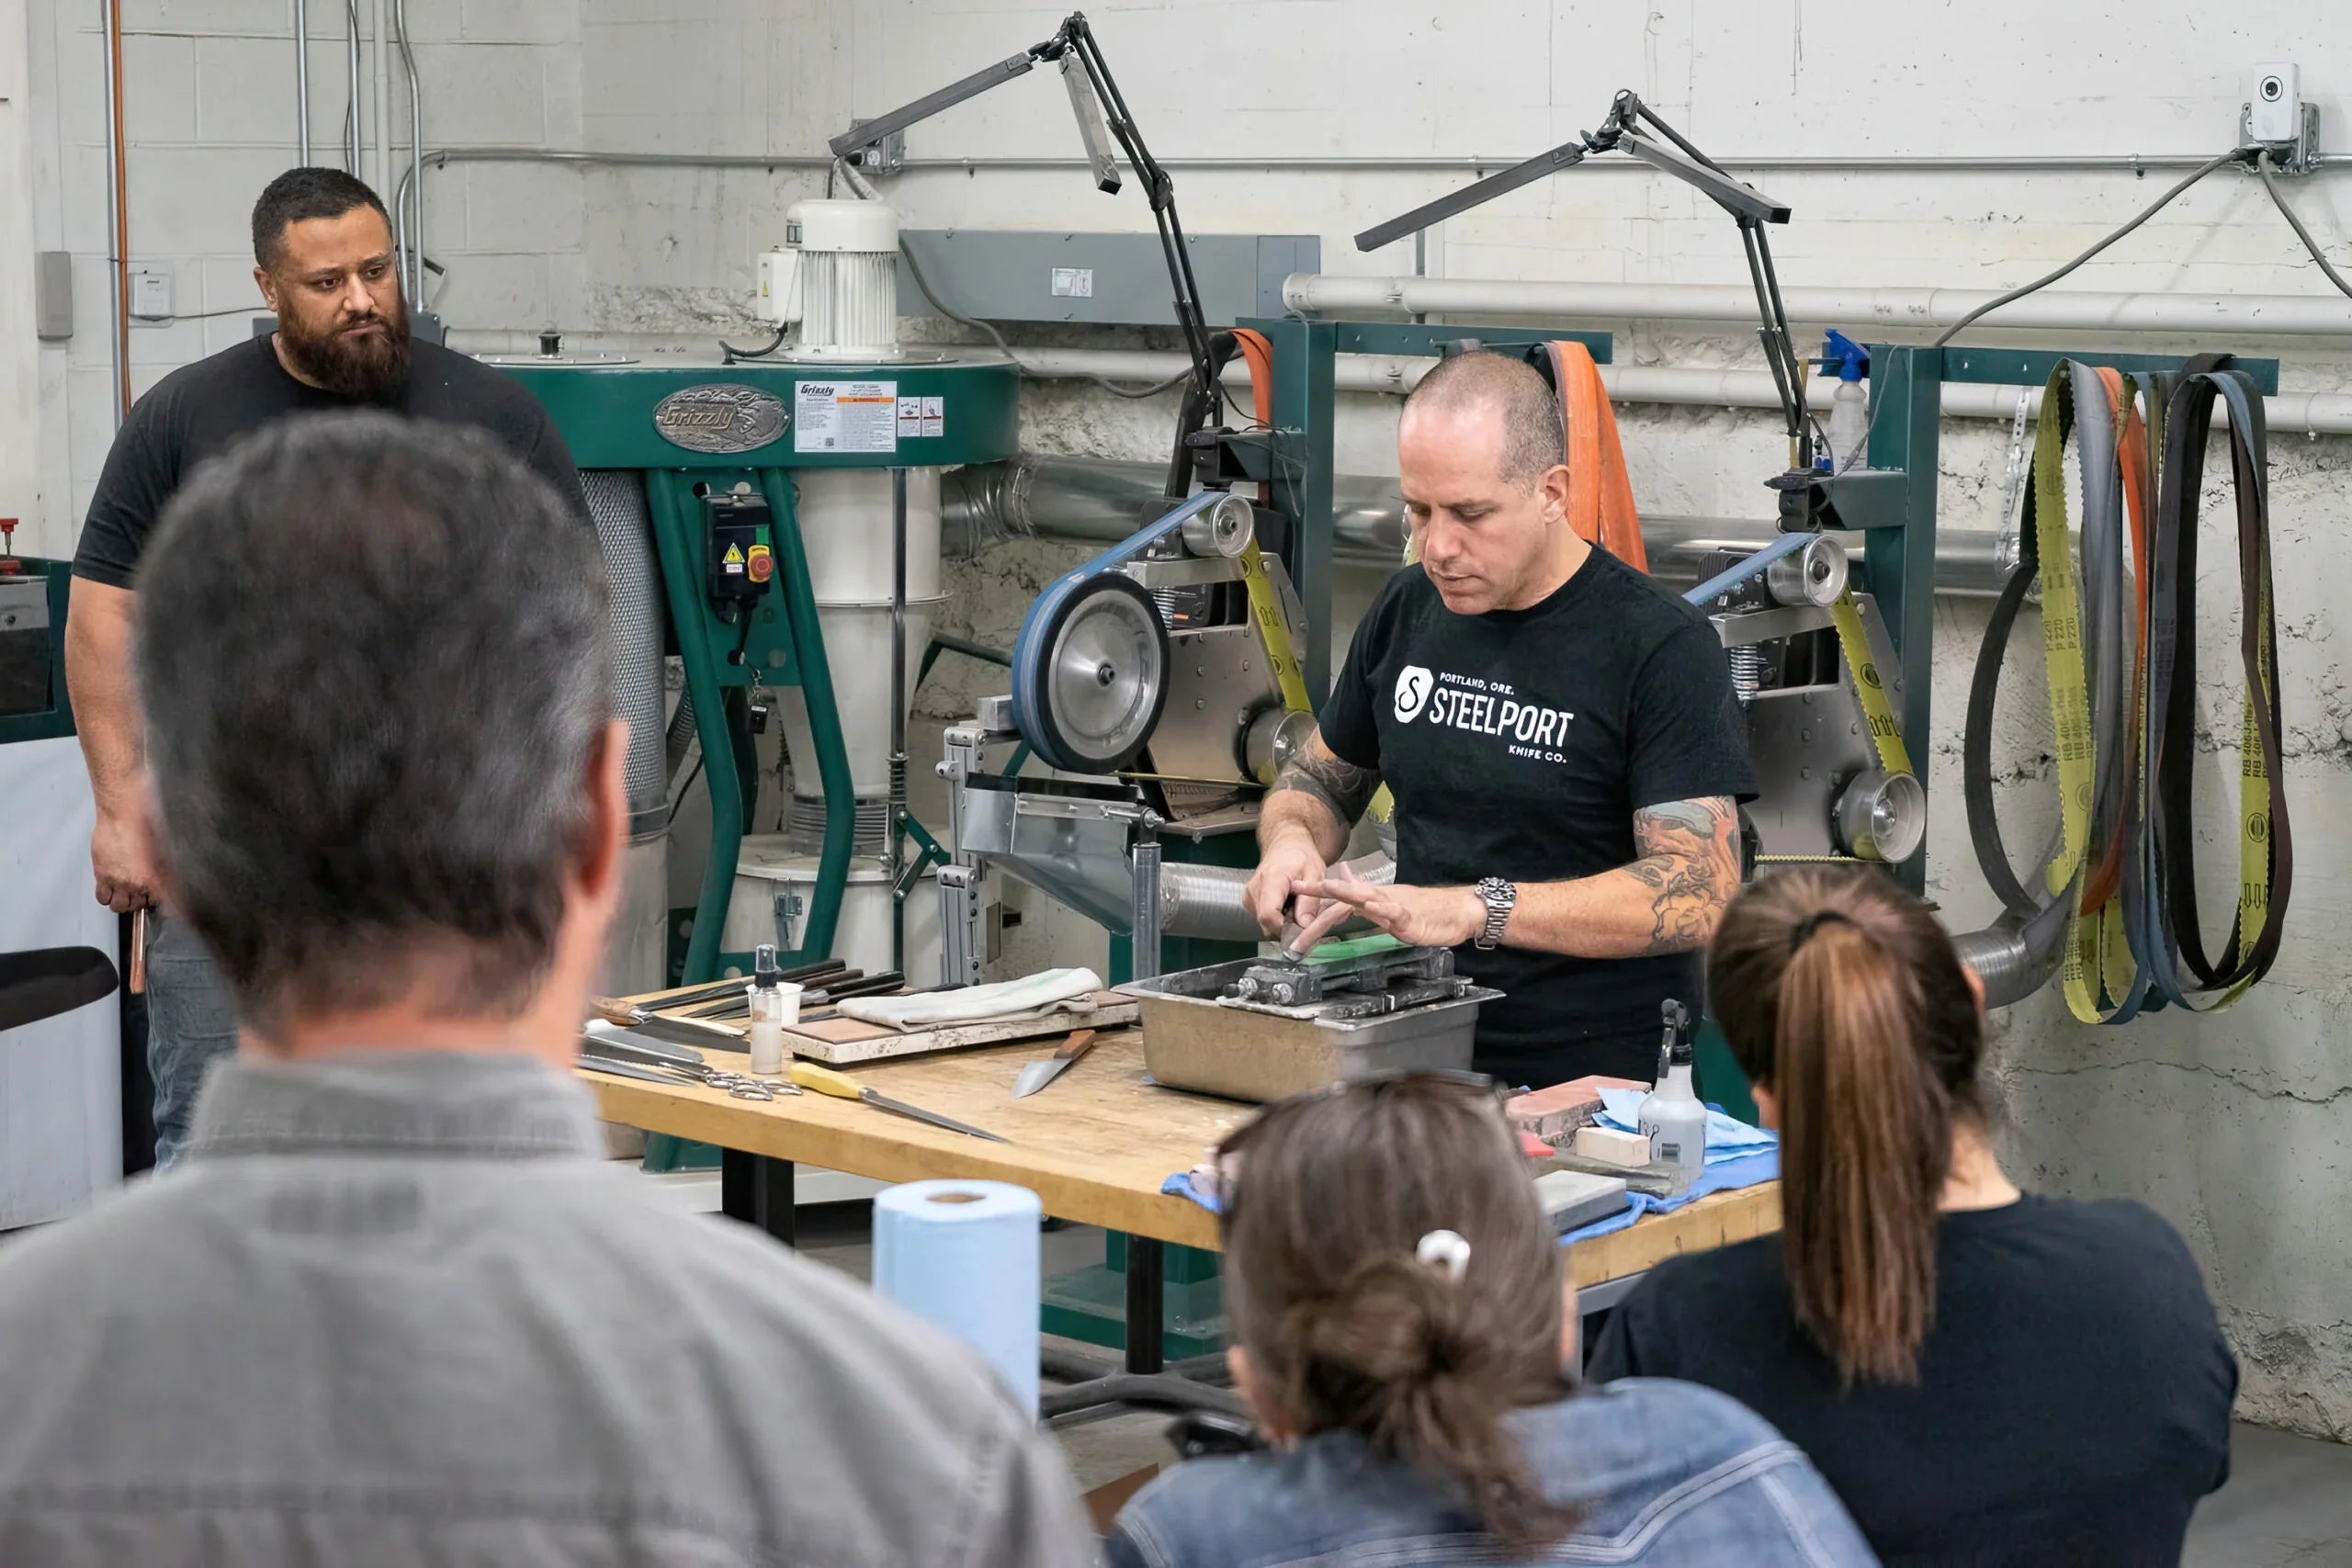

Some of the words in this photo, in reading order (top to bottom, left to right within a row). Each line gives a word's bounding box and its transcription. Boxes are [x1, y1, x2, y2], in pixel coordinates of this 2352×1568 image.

[801, 384, 834, 397] Grizzly
[662, 403, 736, 431] Grizzly
[2054, 619, 2064, 640] 220
[2066, 617, 2076, 638] 220
[2056, 642, 2065, 651] P
[2068, 640, 2076, 649] P
[1440, 671, 1487, 691] PORTLAND,
[1490, 681, 1515, 695] ORE.
[1429, 687, 1574, 748] STEELPORT
[1509, 744, 1542, 761] KNIFE
[1544, 751, 1567, 764] CO.
[2062, 743, 2073, 761] RB
[2074, 742, 2086, 761] RB
[2242, 760, 2251, 777] RB
[2253, 761, 2261, 778] RB
